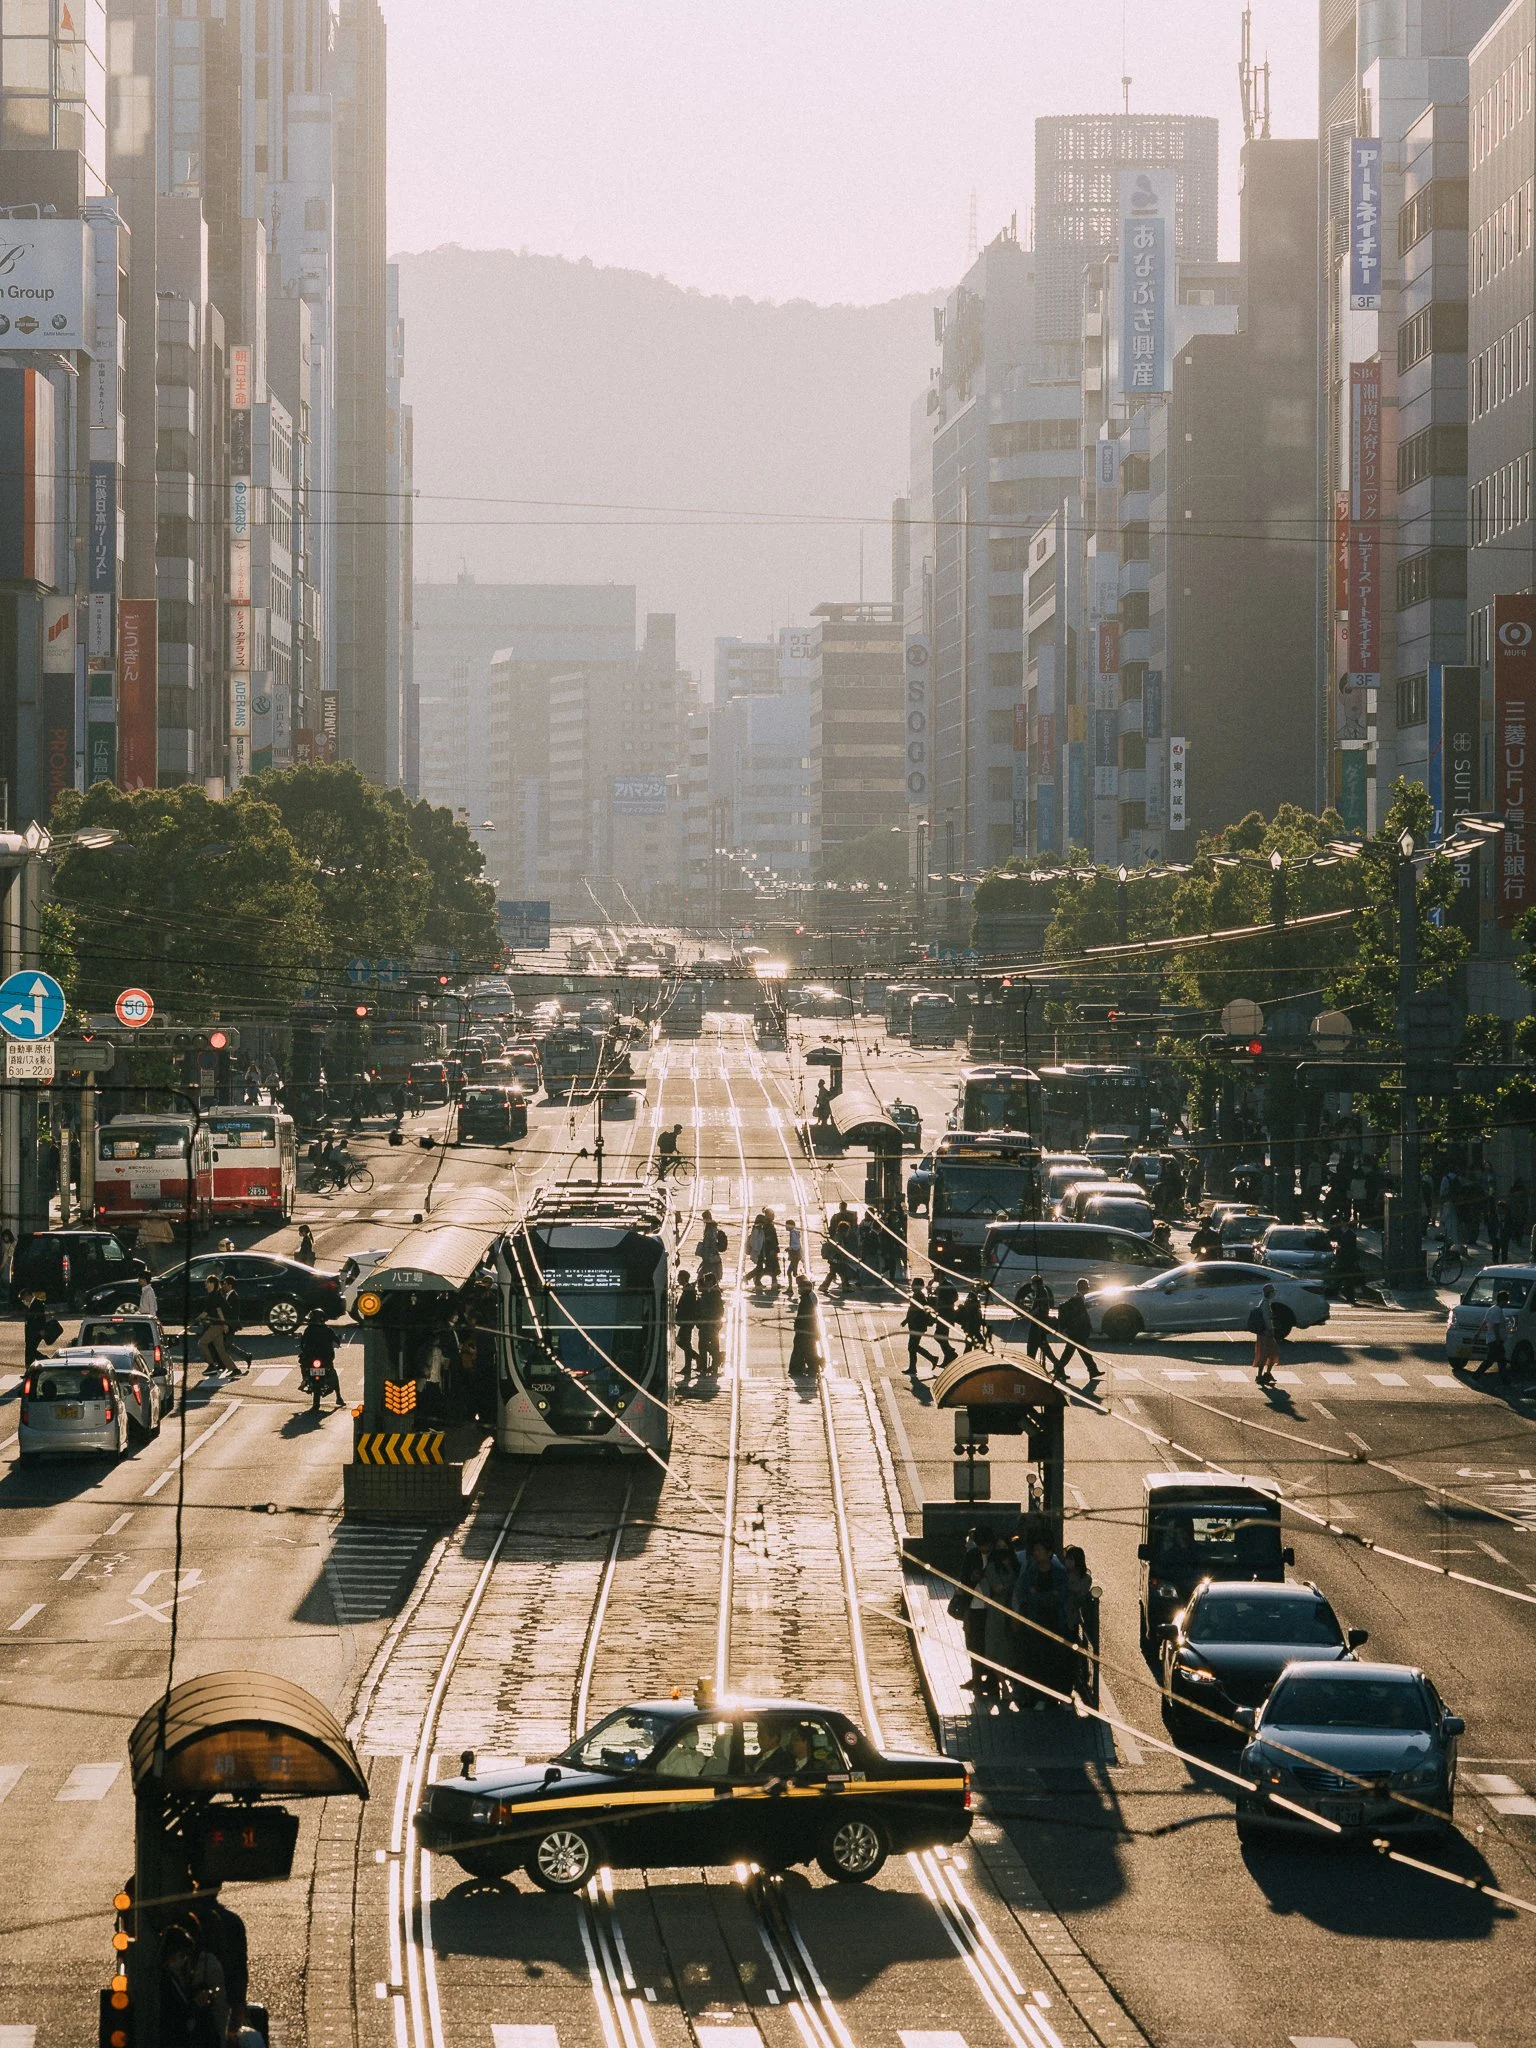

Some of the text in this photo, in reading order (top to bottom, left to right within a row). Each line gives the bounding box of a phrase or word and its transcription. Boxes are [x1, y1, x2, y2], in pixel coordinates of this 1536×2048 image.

[1356, 150, 1377, 284] アートネイチャー
[8, 285, 54, 301] Group
[1132, 225, 1155, 387] あなぶき興産
[1357, 297, 1375, 308] 3F
[235, 350, 247, 405] 朝日生命
[1353, 368, 1378, 379] SBC
[1363, 384, 1378, 520] 湘南美容クリニック
[95, 475, 107, 579] 近畿日本ツーリスト
[1359, 532, 1371, 668] レディース アートネイチャー
[124, 615, 139, 681] ごうぎん
[235, 631, 246, 666] アデランス
[1504, 649, 1526, 657] MUFG
[234, 680, 246, 727] ADERANS
[1355, 674, 1372, 686] 3F
[907, 680, 926, 794] SOGO
[1173, 762, 1183, 822] 東洋証券
[1504, 701, 1526, 899] 三菱UFJ信託銀行
[1454, 760, 1470, 889] SUIT SQARE
[125, 1000, 144, 1016] 50
[9, 1045, 52, 1054] 自動車 原付
[392, 1272, 423, 1282] 八丁堀
